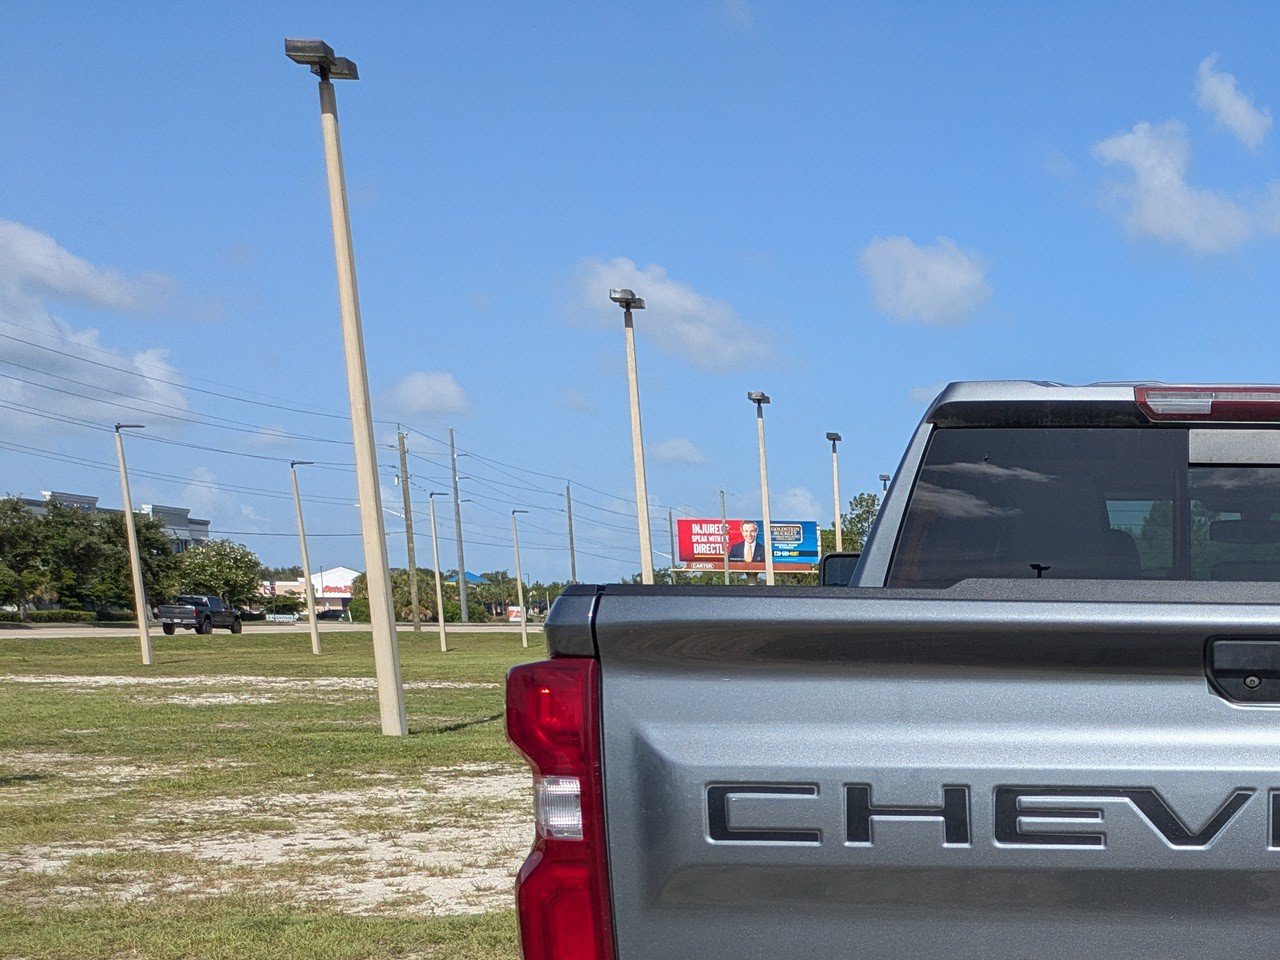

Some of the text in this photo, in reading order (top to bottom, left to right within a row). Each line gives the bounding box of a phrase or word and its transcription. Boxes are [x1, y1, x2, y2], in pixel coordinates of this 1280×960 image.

[691, 535, 708, 543] SPEAK
[709, 535, 721, 543] WITH
[693, 543, 728, 554] DIRECTL
